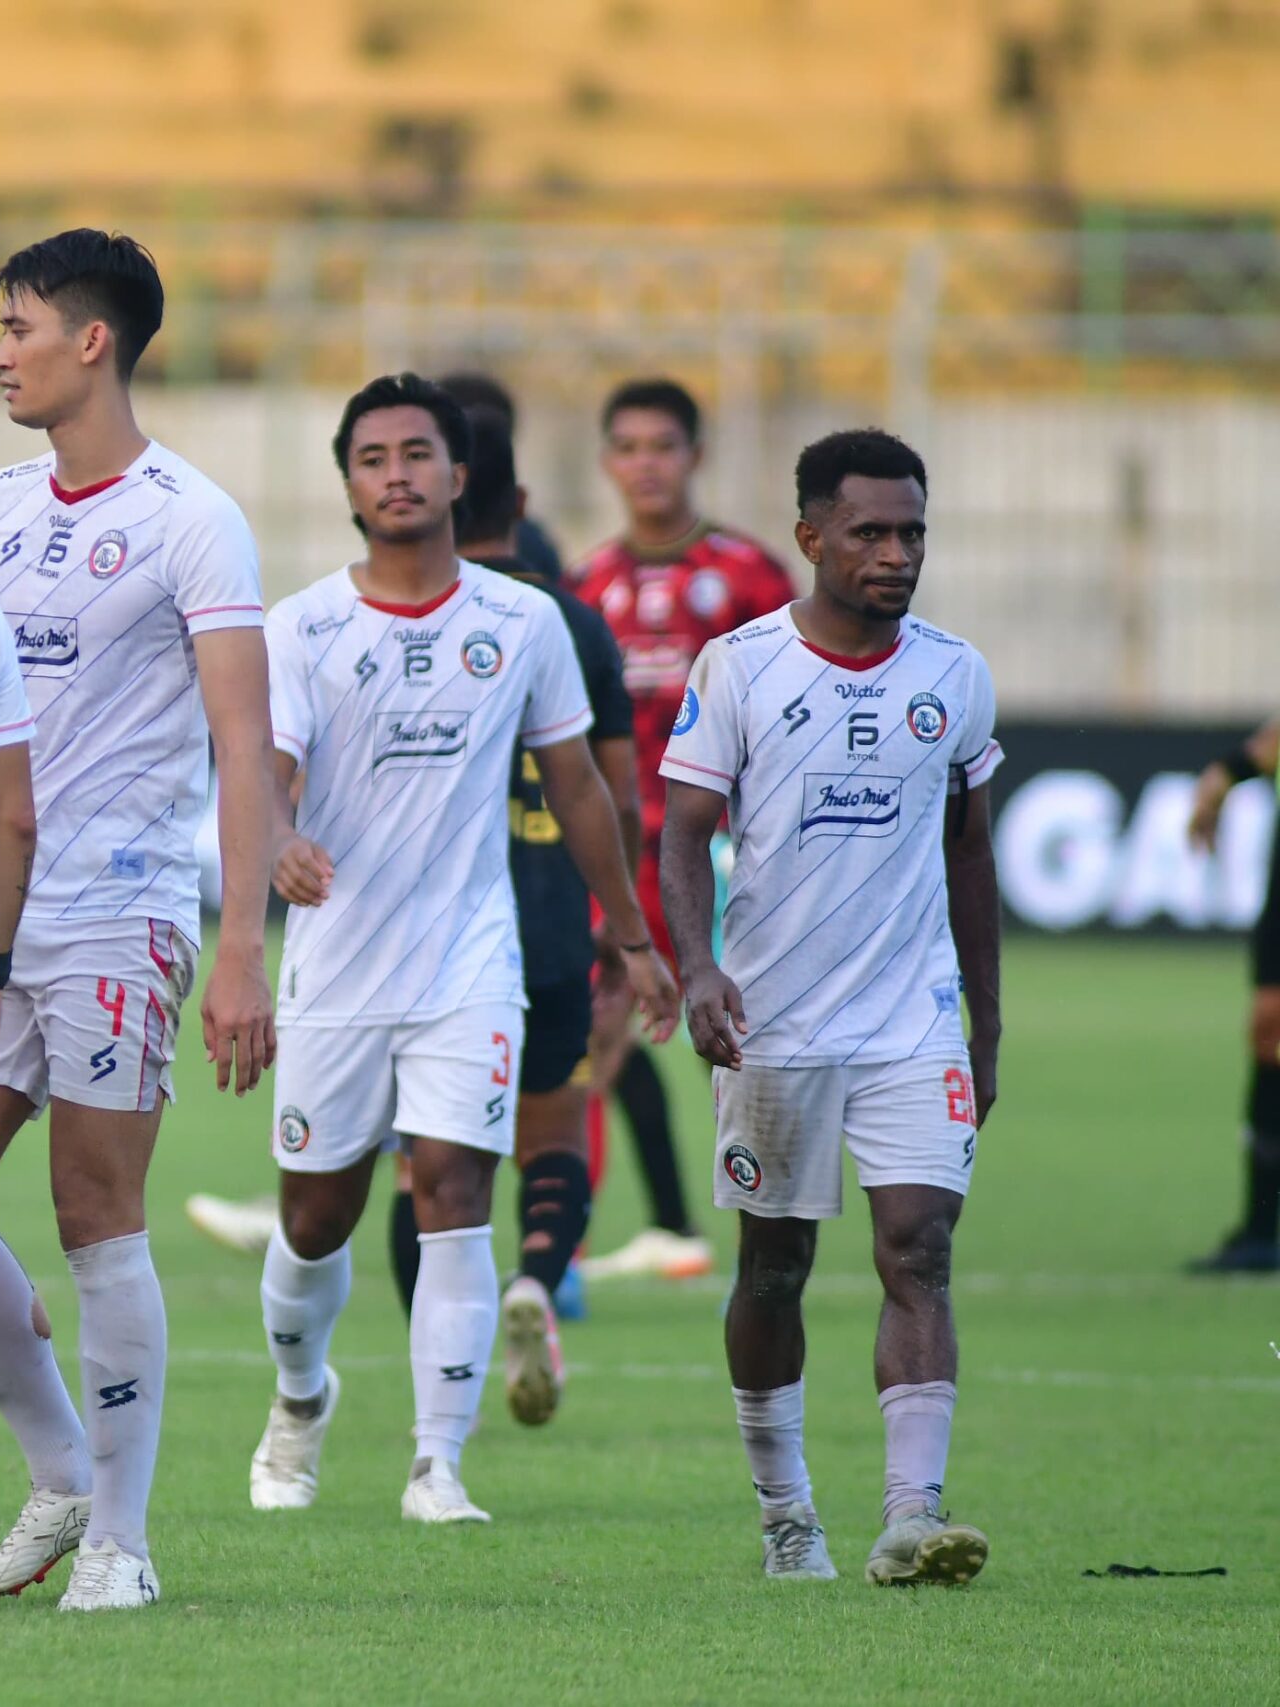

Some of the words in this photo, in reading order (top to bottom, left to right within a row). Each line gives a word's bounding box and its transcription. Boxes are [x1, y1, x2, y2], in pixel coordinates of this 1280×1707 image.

[393, 628, 442, 644] Vidio
[835, 683, 887, 699] Vidio
[847, 753, 880, 761] PSTORE
[96, 976, 126, 1036] 4
[491, 1031, 512, 1086] 3
